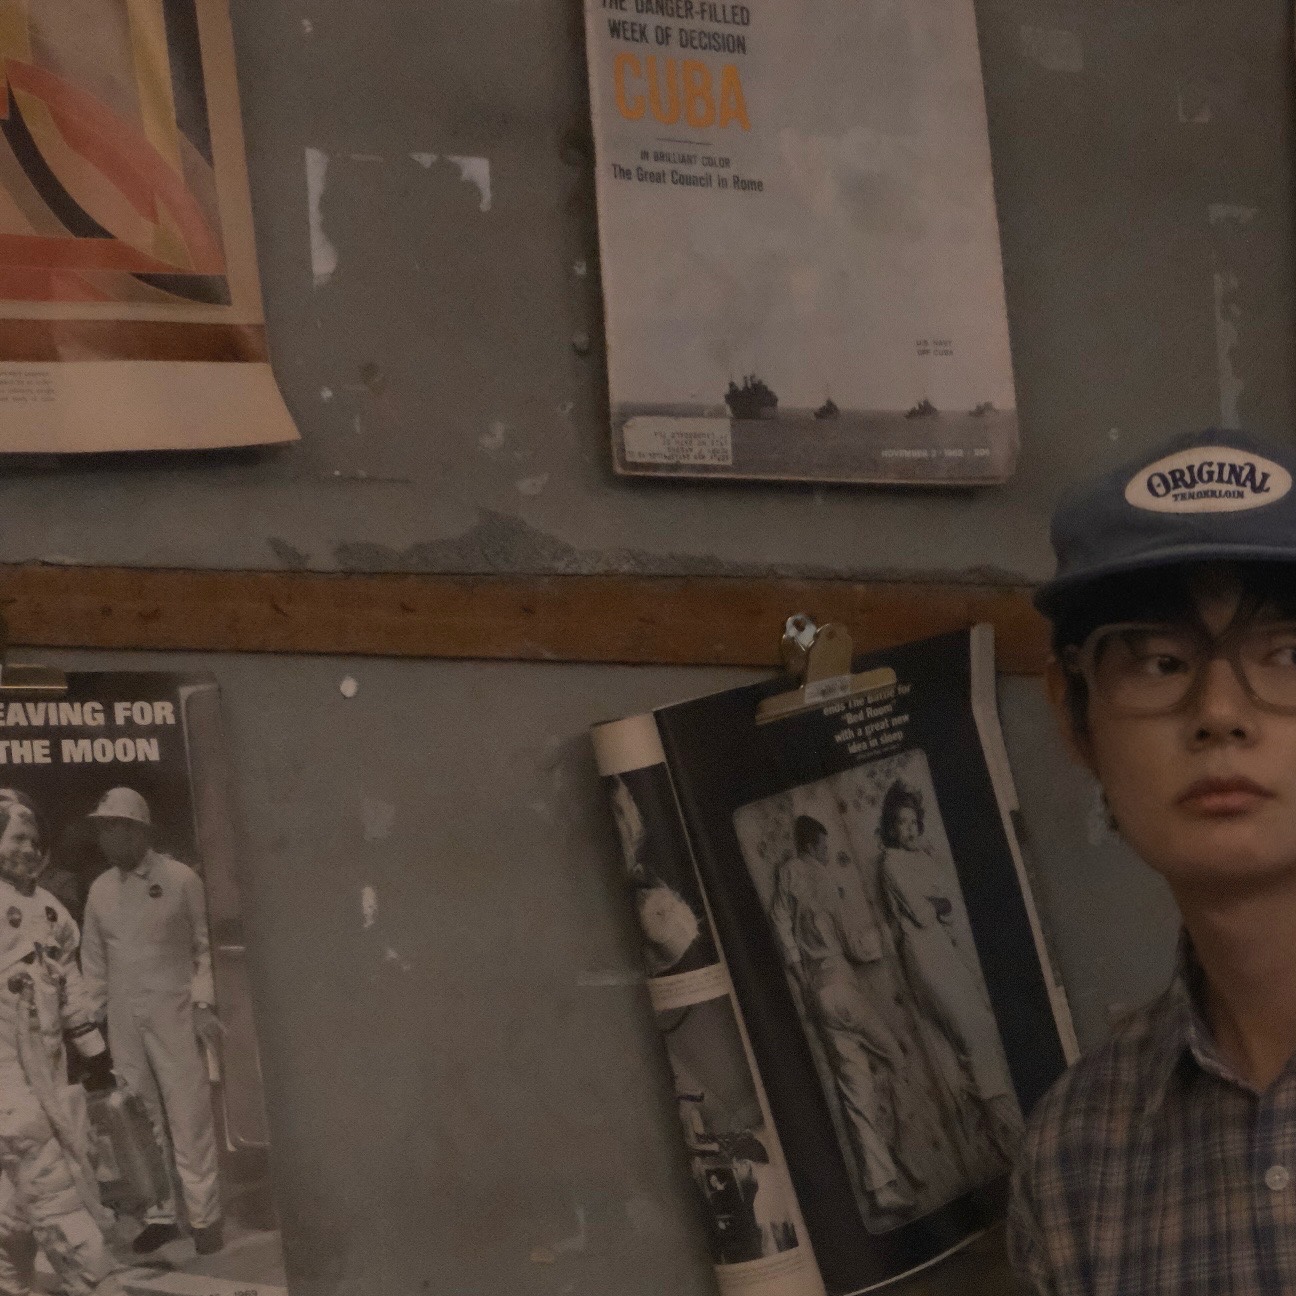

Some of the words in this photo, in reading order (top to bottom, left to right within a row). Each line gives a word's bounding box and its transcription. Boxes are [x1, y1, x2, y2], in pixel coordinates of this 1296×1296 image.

[635, 0, 750, 26] DANGER-FILLED
[608, 18, 649, 44] WEEK
[655, 25, 672, 46] OF
[679, 28, 746, 54] DECISION
[614, 53, 751, 132] CUBA
[653, 151, 697, 166] BRILLIANT
[702, 156, 731, 168] COLOR
[612, 164, 632, 180] The
[636, 167, 666, 184] Great
[671, 170, 712, 188] Council
[717, 175, 728, 188] in
[733, 176, 763, 191] Rome
[1147, 461, 1271, 498] ORIGINAL
[0, 701, 105, 726] AVING
[114, 701, 176, 726] FOR
[0, 739, 52, 764] THE
[61, 737, 160, 764] MOON
